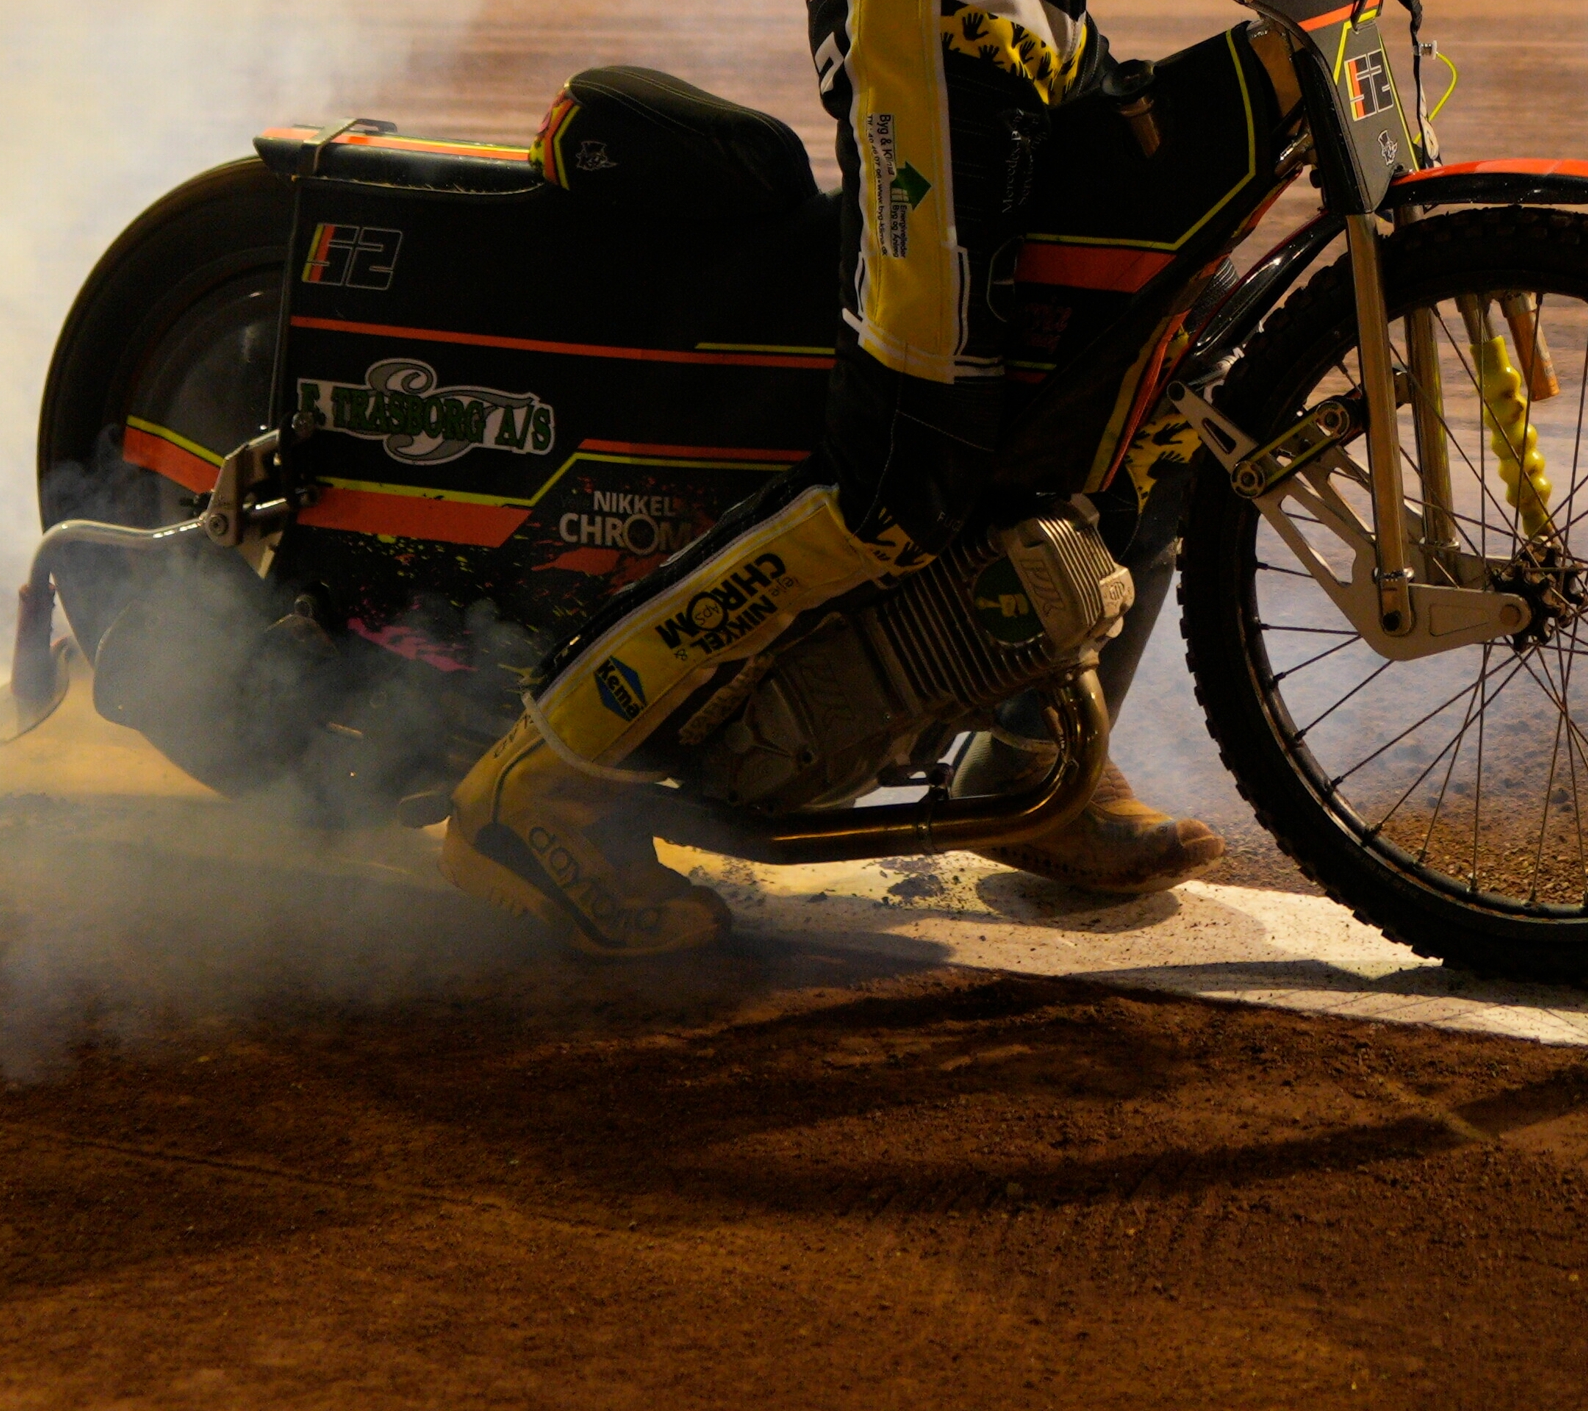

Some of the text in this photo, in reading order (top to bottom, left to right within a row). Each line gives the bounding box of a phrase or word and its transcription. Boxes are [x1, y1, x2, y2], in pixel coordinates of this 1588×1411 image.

[876, 114, 892, 135] Byg
[879, 138, 892, 146] &
[331, 386, 486, 443] TRASBORG
[495, 404, 552, 451] A/S
[592, 490, 676, 517] NIKKEL
[559, 512, 692, 556] CHROM
[655, 553, 786, 649] CHROM
[695, 602, 720, 627] ApS
[690, 594, 779, 654] NIKKEL
[596, 657, 643, 720] Kema
